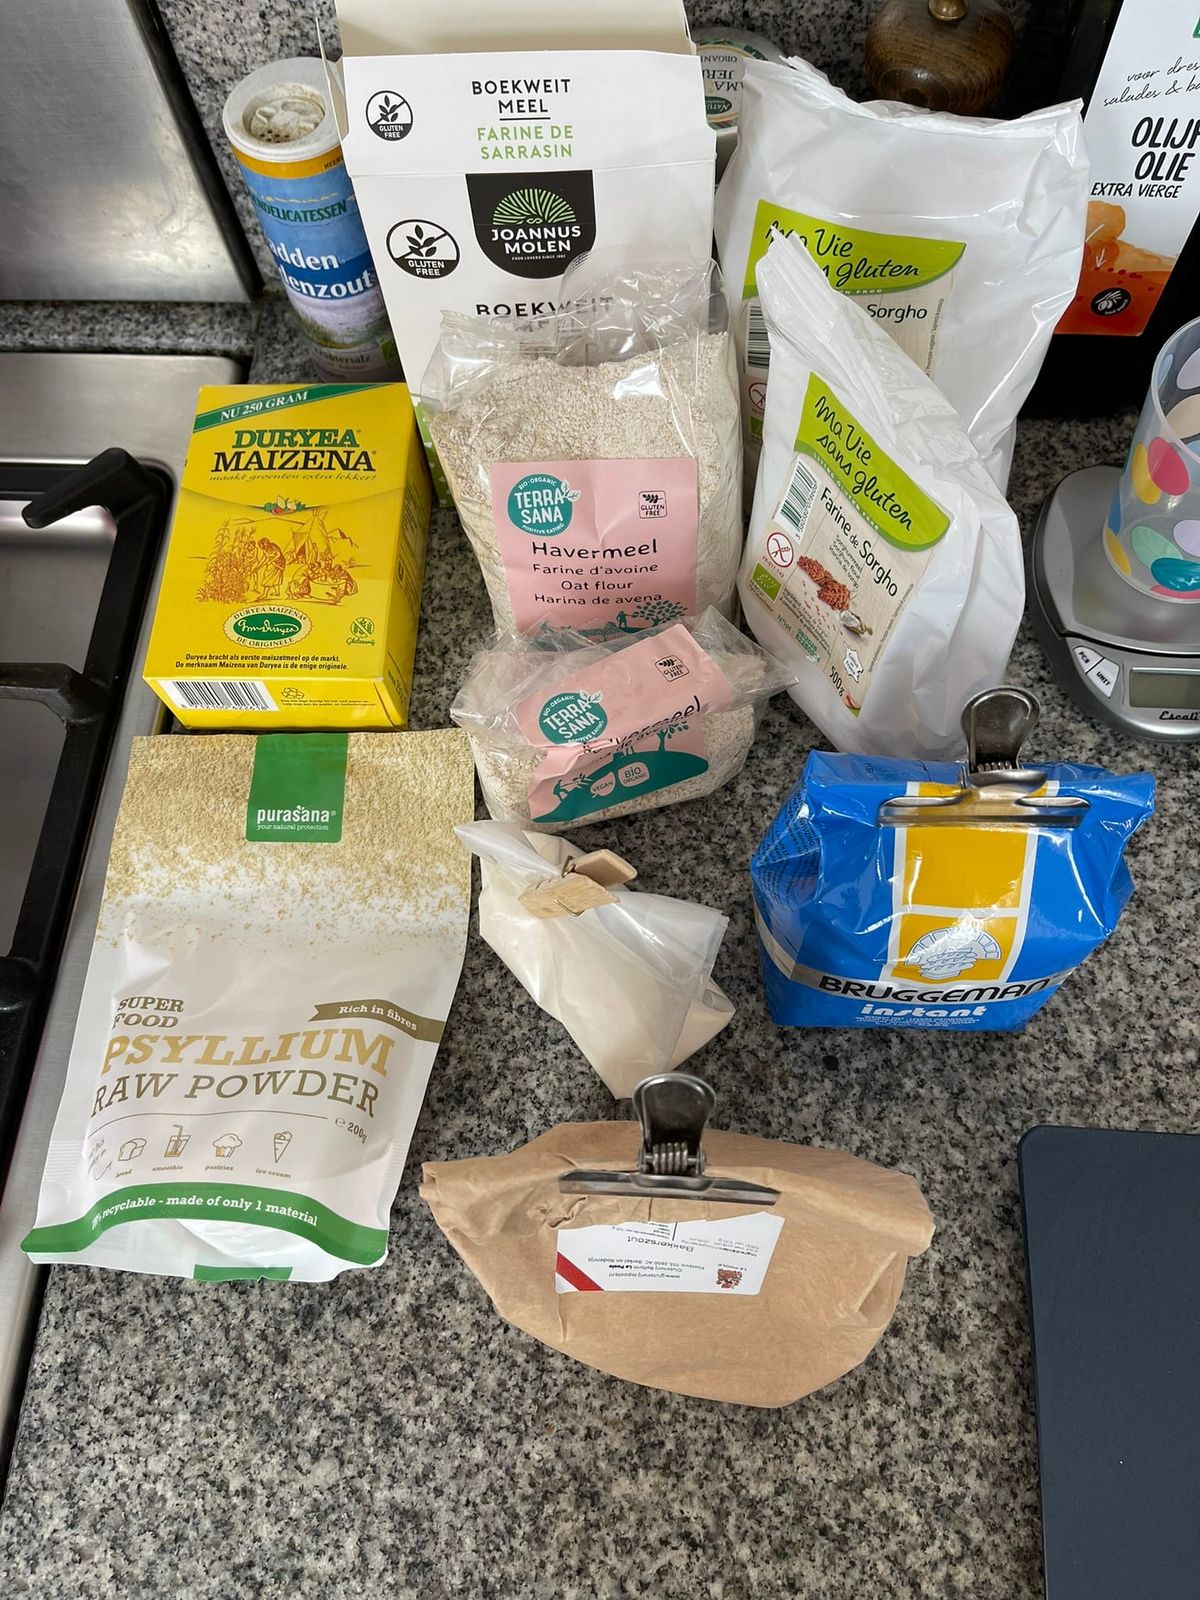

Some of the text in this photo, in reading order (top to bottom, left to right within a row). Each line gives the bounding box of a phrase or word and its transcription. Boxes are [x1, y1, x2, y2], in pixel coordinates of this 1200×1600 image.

[471, 78, 571, 95] BOEKWEIT
[1104, 83, 1161, 107] salades
[498, 99, 549, 114] MEEL
[379, 125, 404, 133] GLUTEN
[477, 124, 574, 141] FARINE DE
[481, 144, 573, 160] SARRASIN
[1135, 151, 1195, 181] OLIE
[1090, 182, 1182, 198] EXTRA VIERGE
[491, 225, 582, 242] JOANNUS
[504, 240, 571, 254] MOLEN
[815, 228, 854, 258] Vie
[408, 259, 445, 270] GLUTEN
[416, 267, 441, 277] FREE
[836, 257, 920, 287] gluten
[866, 303, 928, 324] Sorgho
[219, 391, 309, 421] NU 250 GRAM
[232, 429, 360, 449] DURYEA
[814, 395, 872, 467] Ma Vie
[211, 450, 376, 473] MAIZENA
[816, 434, 852, 476] sans
[852, 470, 912, 533] gluten
[514, 489, 565, 509] TERRA
[640, 503, 665, 511] GLUTEN
[521, 507, 564, 524] SANA
[532, 538, 658, 559] Havermeel
[820, 486, 852, 537] Farine
[850, 534, 860, 549] de
[859, 540, 898, 597] Sorgho
[533, 563, 658, 576] Farine d'avoine
[561, 580, 634, 591] Oat flour
[534, 593, 662, 606] Harina de avena
[233, 606, 268, 620] DURYEA
[236, 636, 295, 647] DE ORIGINELE
[185, 654, 207, 662] Duryea
[261, 654, 300, 662] maiszetmeel
[219, 661, 246, 669] Maizena
[260, 662, 281, 670] Duryea
[300, 662, 317, 670] enige
[319, 662, 348, 670] originele.
[663, 664, 684, 677] GLUTEN
[670, 669, 684, 679] FREE
[1096, 671, 1111, 687] UNIT
[543, 699, 592, 730] TERRA
[1159, 710, 1199, 721] Escali
[558, 711, 600, 739] SANA
[592, 781, 613, 793] VEGAN
[623, 772, 647, 785] ORGANIC
[256, 807, 330, 825] purasana
[818, 974, 1050, 1003] BRUGGEMAN
[118, 996, 184, 1013] SUPER
[860, 1003, 988, 1017] instant
[112, 1012, 179, 1029] FOOD
[339, 1003, 418, 1031] Rich in fibres
[100, 1028, 396, 1078] PSYLLIUM
[90, 1069, 380, 1119] RAW POWDER
[102, 1196, 156, 1219] recyclable
[166, 1195, 204, 1207] made
[206, 1195, 221, 1207] of
[222, 1198, 253, 1213] only
[256, 1200, 262, 1211] 1
[264, 1202, 319, 1227] material
